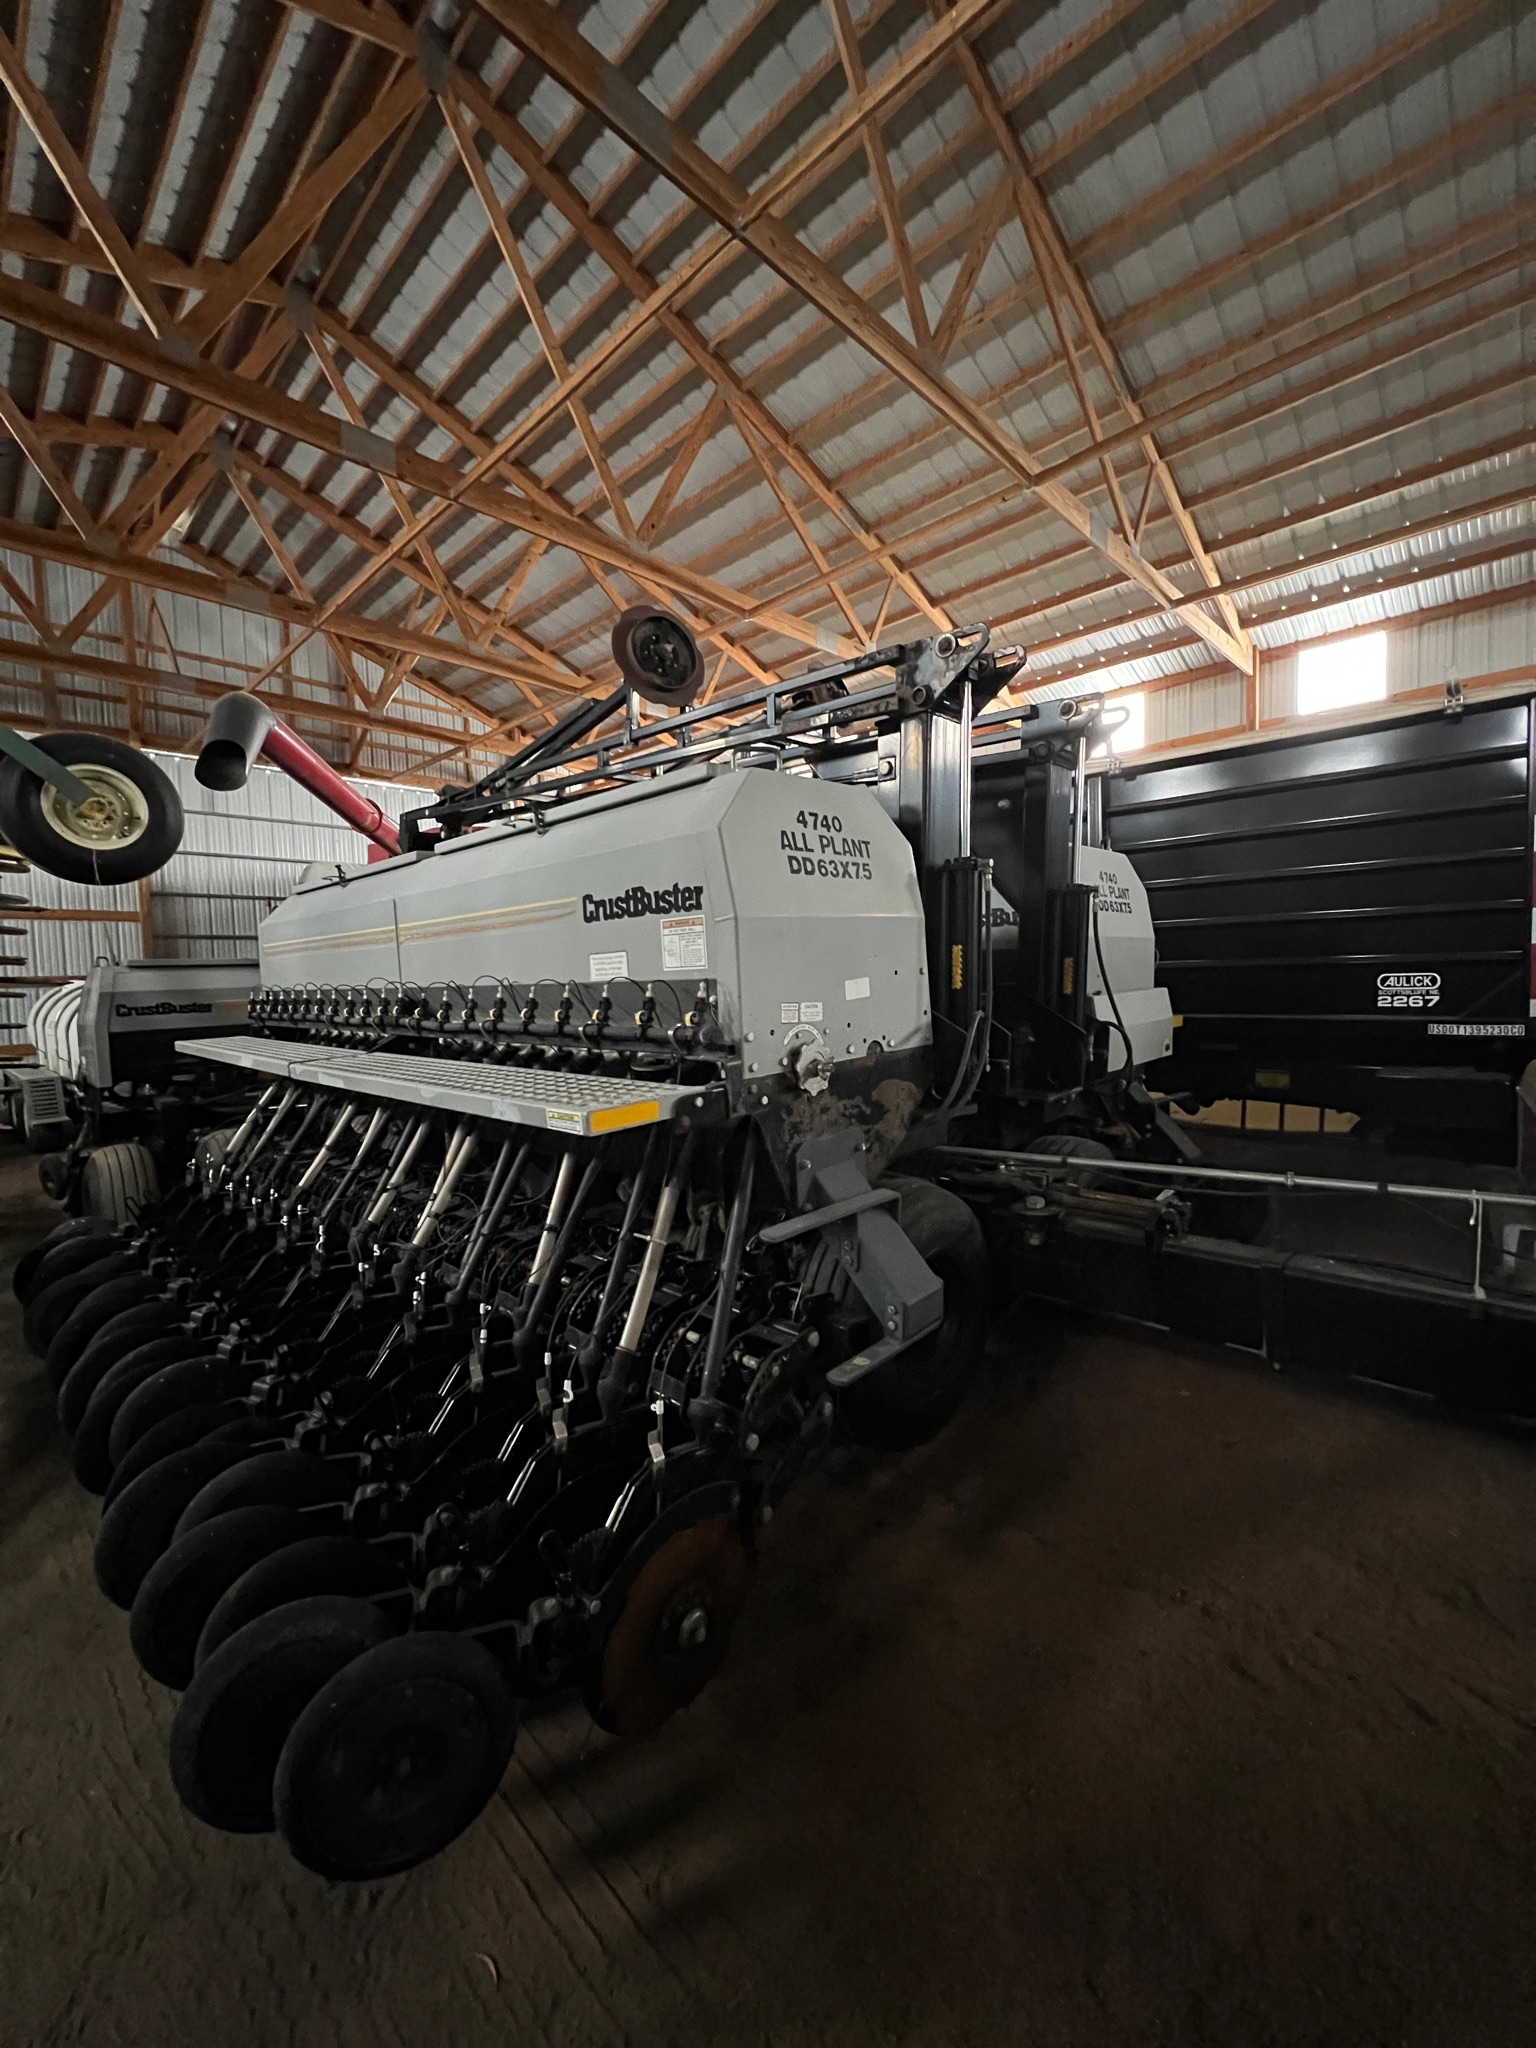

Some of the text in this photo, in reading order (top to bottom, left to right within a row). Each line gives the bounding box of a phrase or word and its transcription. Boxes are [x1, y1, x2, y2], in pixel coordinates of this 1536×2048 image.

[796, 810, 843, 834] 4740
[780, 829, 871, 859] ALL PLANT
[1099, 870, 1118, 885] 4740
[1108, 885, 1130, 900] PLANT
[582, 882, 703, 923] CrustBuster
[1383, 976, 1433, 987] AULICK
[1377, 996, 1440, 1007] 2267
[115, 1002, 213, 1017] CrustBuster
